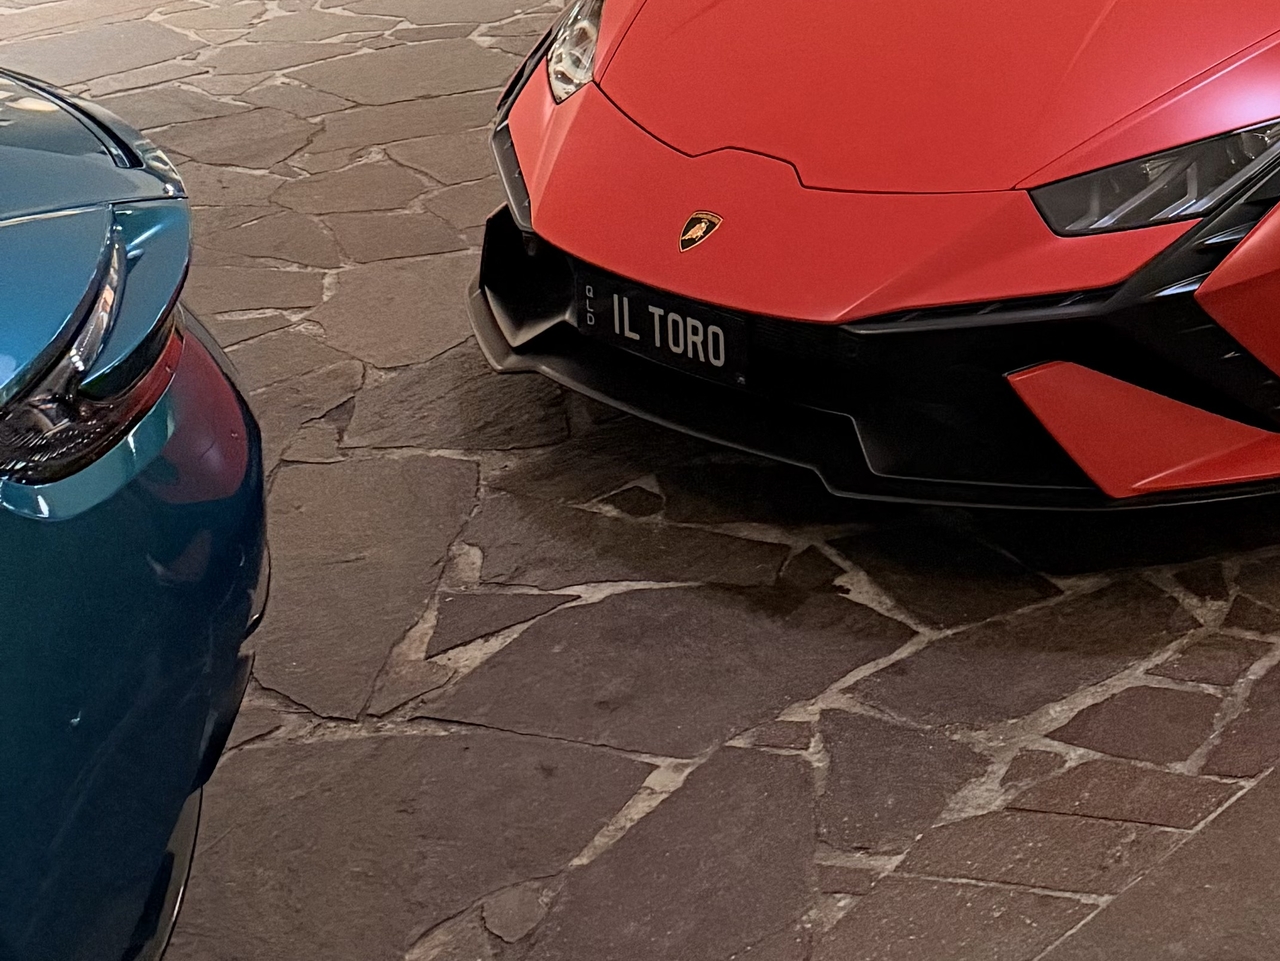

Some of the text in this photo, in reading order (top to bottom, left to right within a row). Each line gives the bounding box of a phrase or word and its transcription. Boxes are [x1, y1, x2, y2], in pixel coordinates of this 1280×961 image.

[585, 285, 595, 325] QLD
[613, 293, 725, 367] IL TORO
